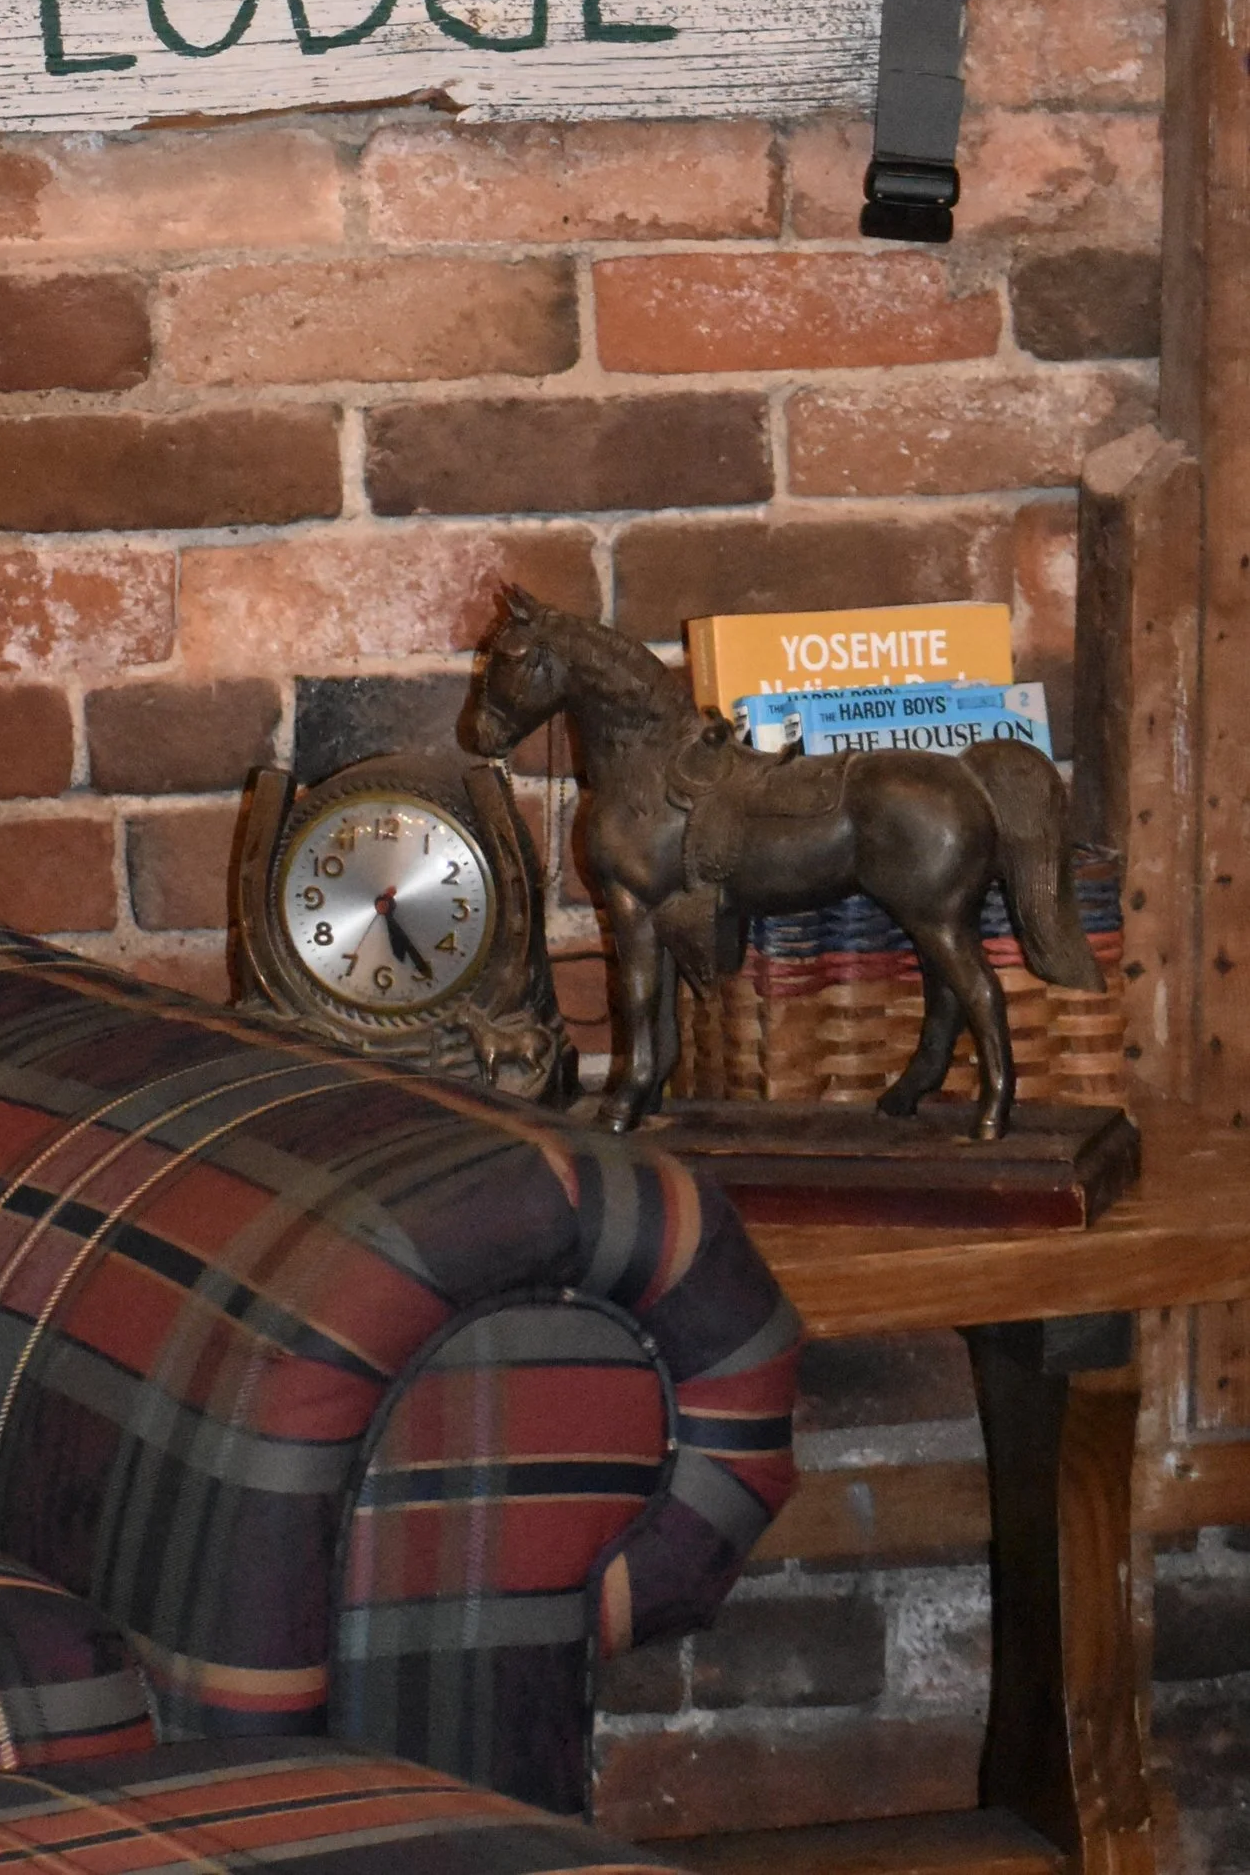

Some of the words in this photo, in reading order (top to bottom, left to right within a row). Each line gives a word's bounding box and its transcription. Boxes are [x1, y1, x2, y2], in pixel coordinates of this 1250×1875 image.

[780, 629, 948, 672] YOSEMITE
[820, 712, 836, 723] THE
[838, 699, 896, 722] HARDY
[902, 695, 947, 717] BOYS
[824, 730, 880, 754] THE
[888, 722, 983, 751] HOUSE
[992, 718, 1034, 742] ON
[312, 855, 345, 878] 10
[440, 860, 461, 886] 2
[303, 885, 326, 911] 9
[452, 897, 471, 923] 3
[313, 921, 334, 947] 8
[434, 932, 458, 955] 4
[341, 953, 358, 977] 7
[373, 965, 394, 991] 6
